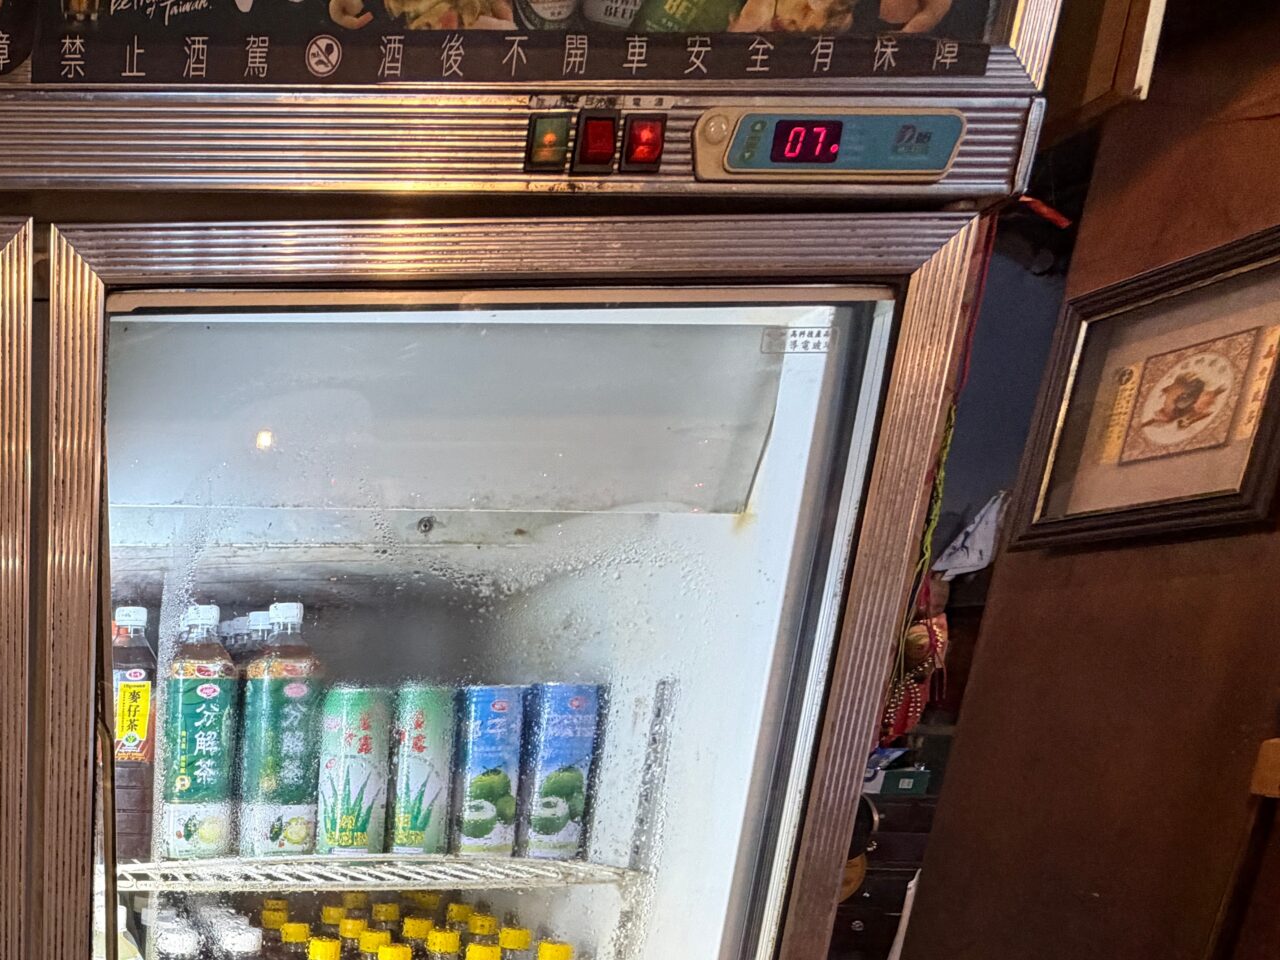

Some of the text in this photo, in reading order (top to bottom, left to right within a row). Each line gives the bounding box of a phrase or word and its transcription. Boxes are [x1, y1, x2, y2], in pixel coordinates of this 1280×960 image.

[60, 34, 959, 78] 禁止酒駕 酒後不開車安全有保障
[127, 690, 141, 732] 麥仔茶
[194, 703, 220, 786] 分解茶
